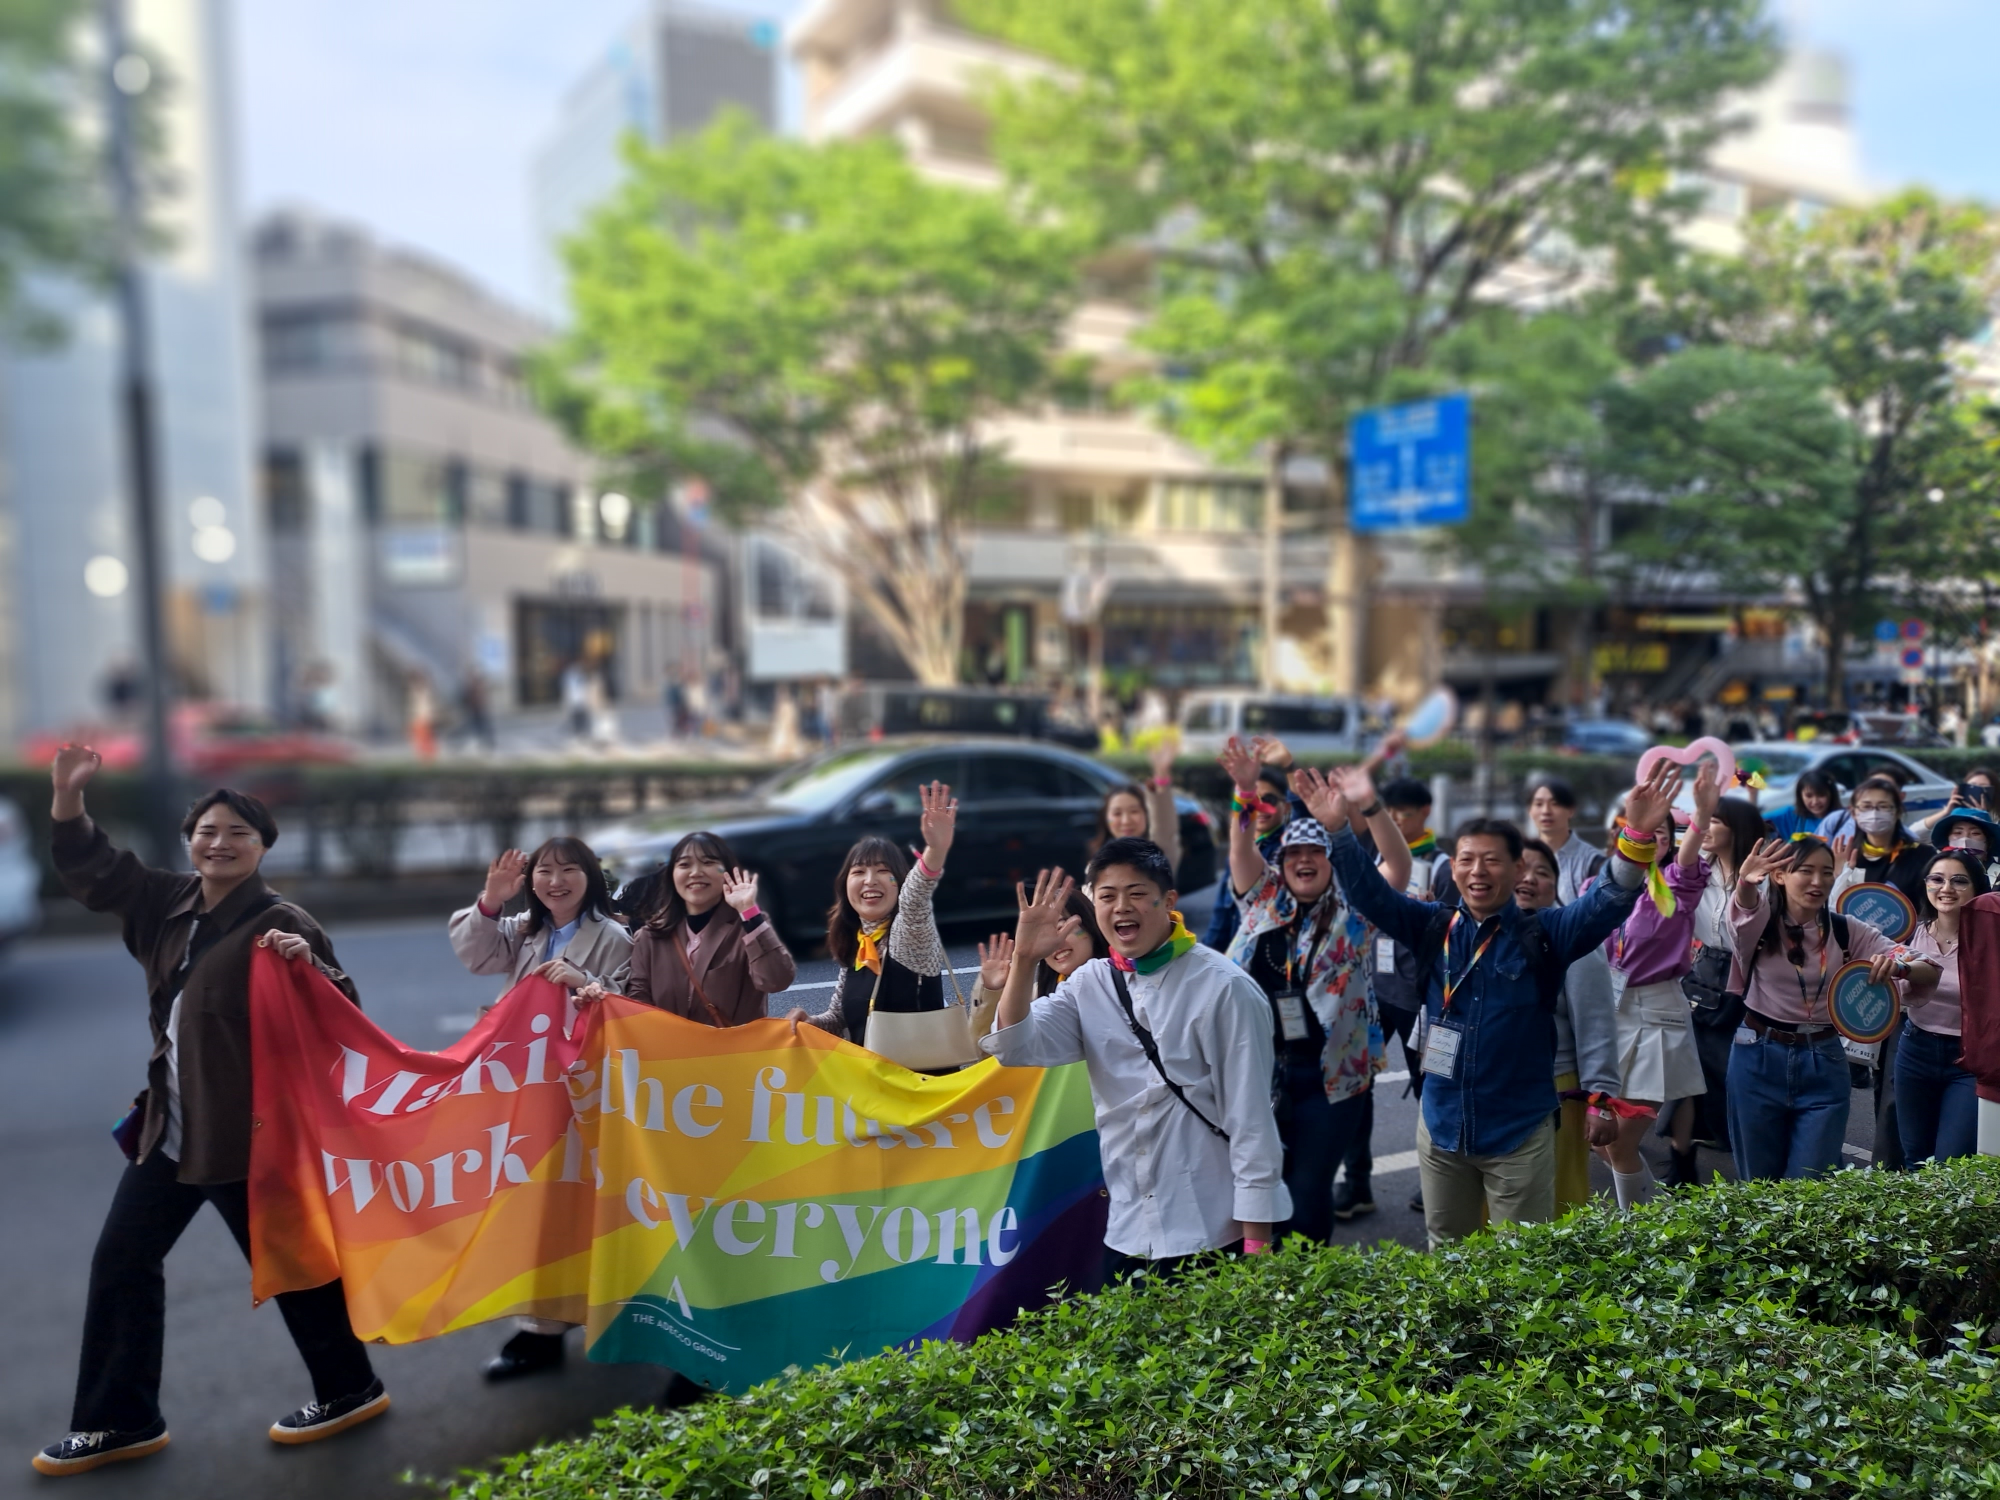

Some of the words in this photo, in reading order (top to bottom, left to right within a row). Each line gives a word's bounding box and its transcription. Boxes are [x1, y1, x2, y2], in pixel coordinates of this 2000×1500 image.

[600, 1046, 723, 1139] the
[321, 1122, 533, 1214] work
[625, 1176, 1021, 1284] everyone
[632, 1313, 655, 1325] THE
[657, 1319, 691, 1347] ADECCO
[692, 1341, 727, 1362] GROUP
